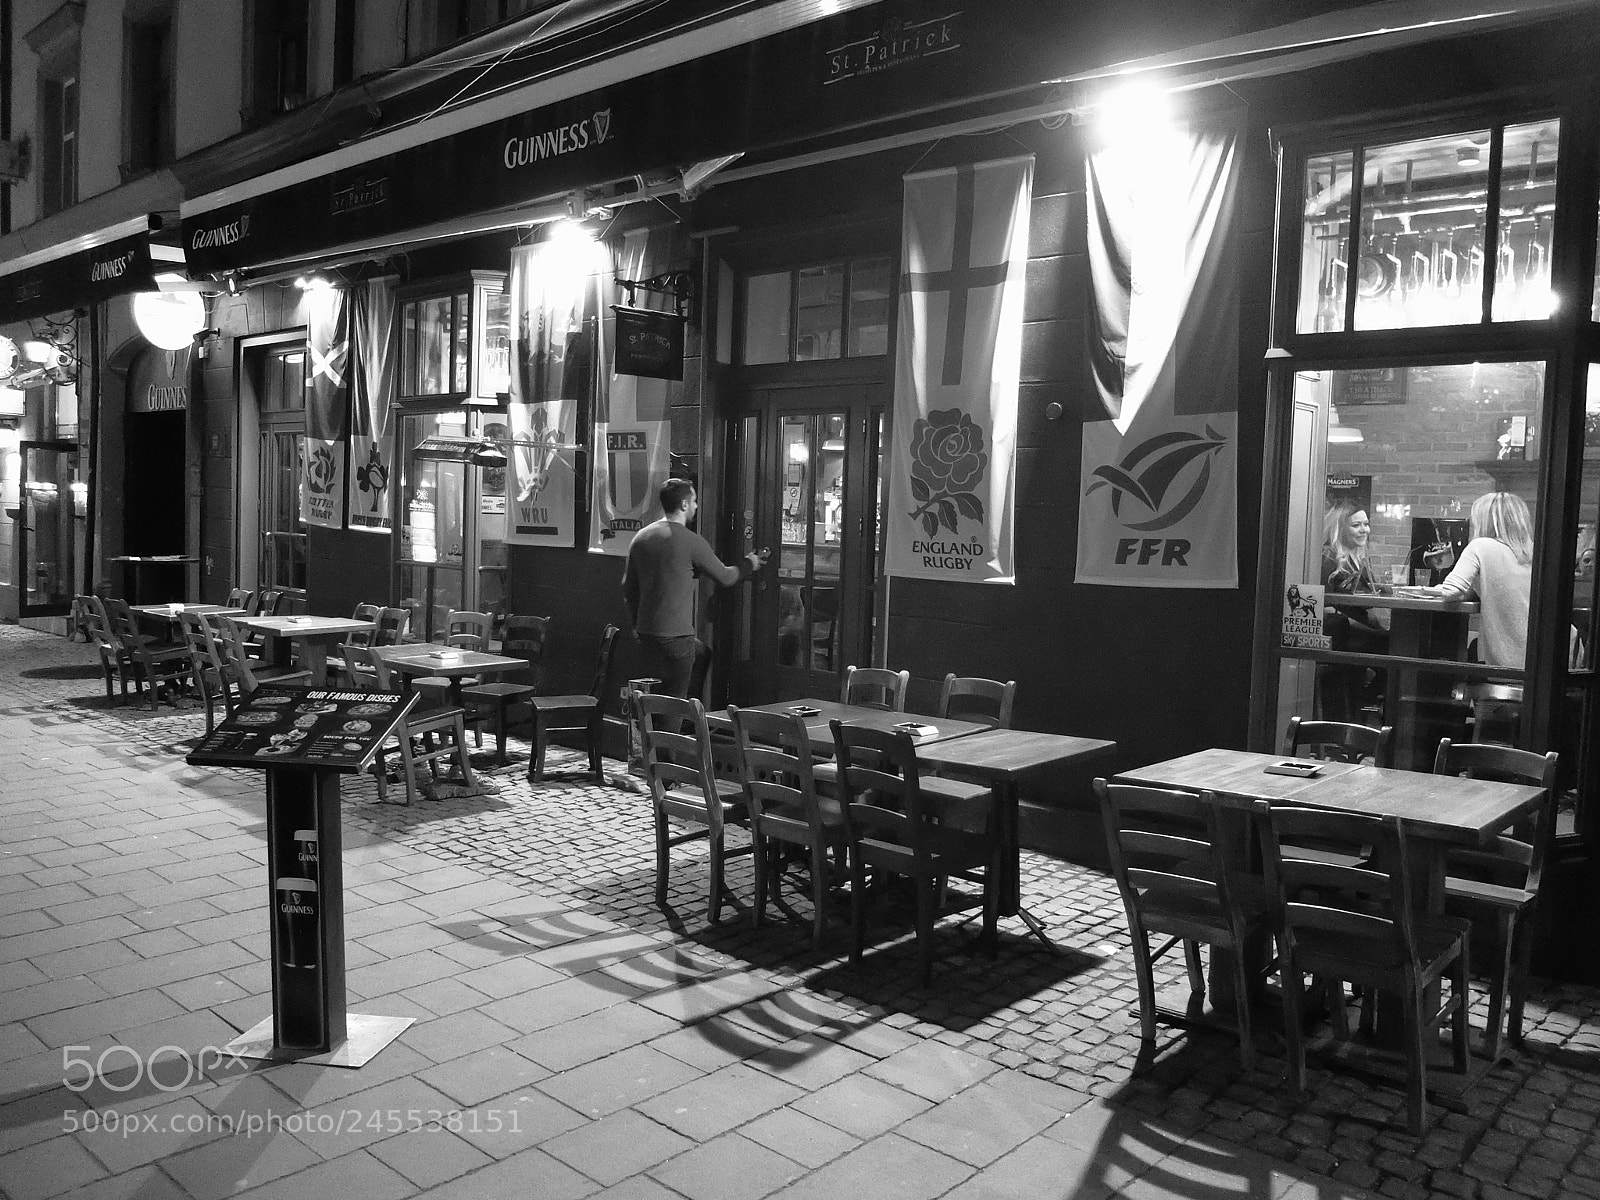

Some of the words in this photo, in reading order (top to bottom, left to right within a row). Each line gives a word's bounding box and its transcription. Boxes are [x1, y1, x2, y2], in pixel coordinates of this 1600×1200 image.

[831, 54, 858, 74] St.
[866, 24, 951, 64] Patrick
[504, 120, 589, 169] GUINNESS
[192, 221, 239, 250] GUINNESS
[91, 256, 126, 282] GUINNESS
[1327, 478, 1357, 486] MAGNERS
[521, 508, 550, 524] WRU
[912, 541, 984, 556] ENGLAND
[1114, 538, 1191, 566] FFR
[923, 556, 973, 570] RUGBY
[1284, 617, 1322, 627] PREMIER
[1285, 625, 1321, 634] LEAGUE
[1297, 636, 1331, 649] SPORTS
[306, 691, 328, 699] OUR
[326, 692, 367, 701] FAMOUS
[365, 694, 401, 703] DISHES
[281, 903, 314, 915] GUINNESS
